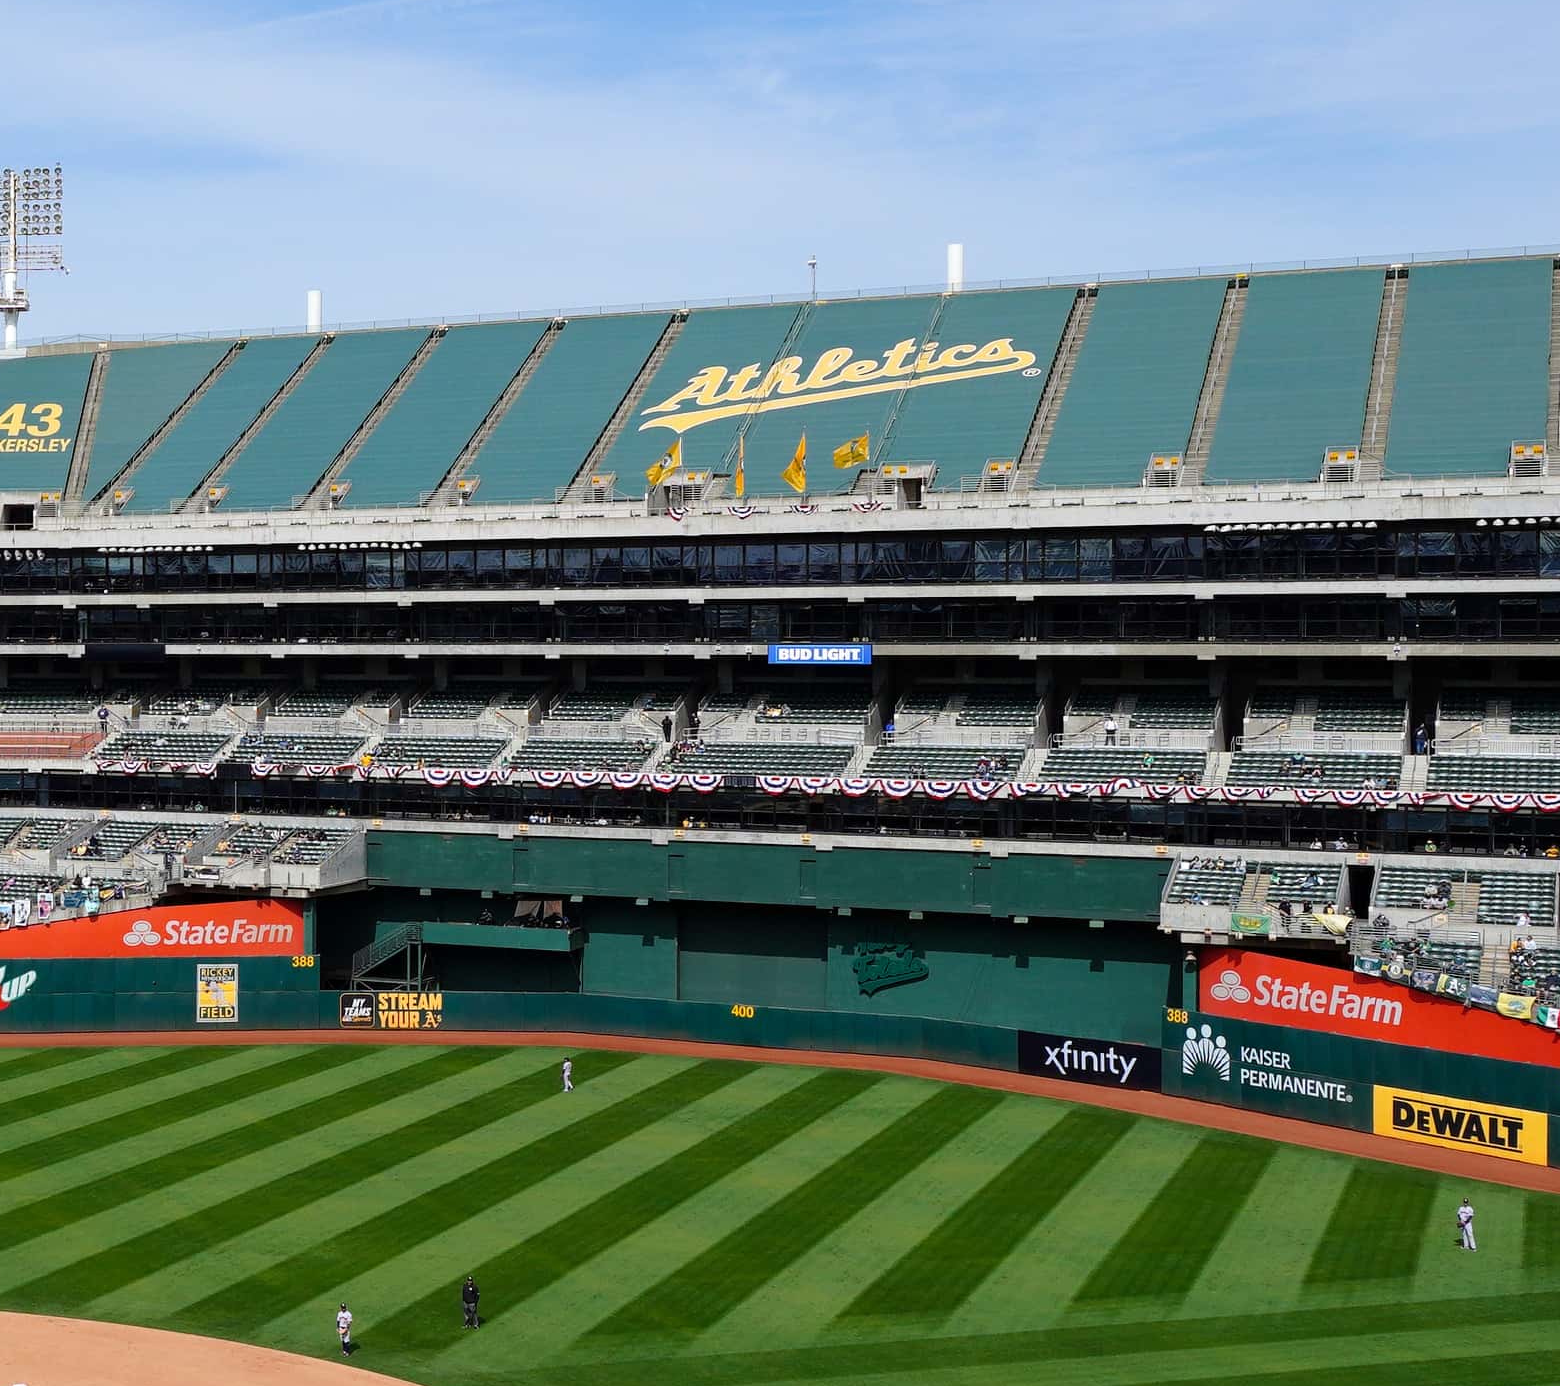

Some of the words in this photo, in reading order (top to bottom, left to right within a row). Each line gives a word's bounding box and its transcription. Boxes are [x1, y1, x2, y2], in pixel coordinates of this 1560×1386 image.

[639, 337, 1037, 433] Athletics
[779, 648, 812, 660] BUD
[813, 648, 861, 660] LIGHT
[292, 955, 314, 968] 388
[200, 967, 234, 977] RICKEY
[352, 998, 365, 1008] MY
[378, 993, 442, 1010] STREAM
[200, 1006, 234, 1019] FIELD
[344, 1007, 372, 1018] TEAMS
[731, 1005, 754, 1018] 400
[1166, 1008, 1188, 1024] 388
[378, 1011, 420, 1028] YOUR
[1044, 1040, 1137, 1084] xfinity
[1240, 1046, 1290, 1069] KAISER
[1240, 1069, 1347, 1103] PERMANENTE
